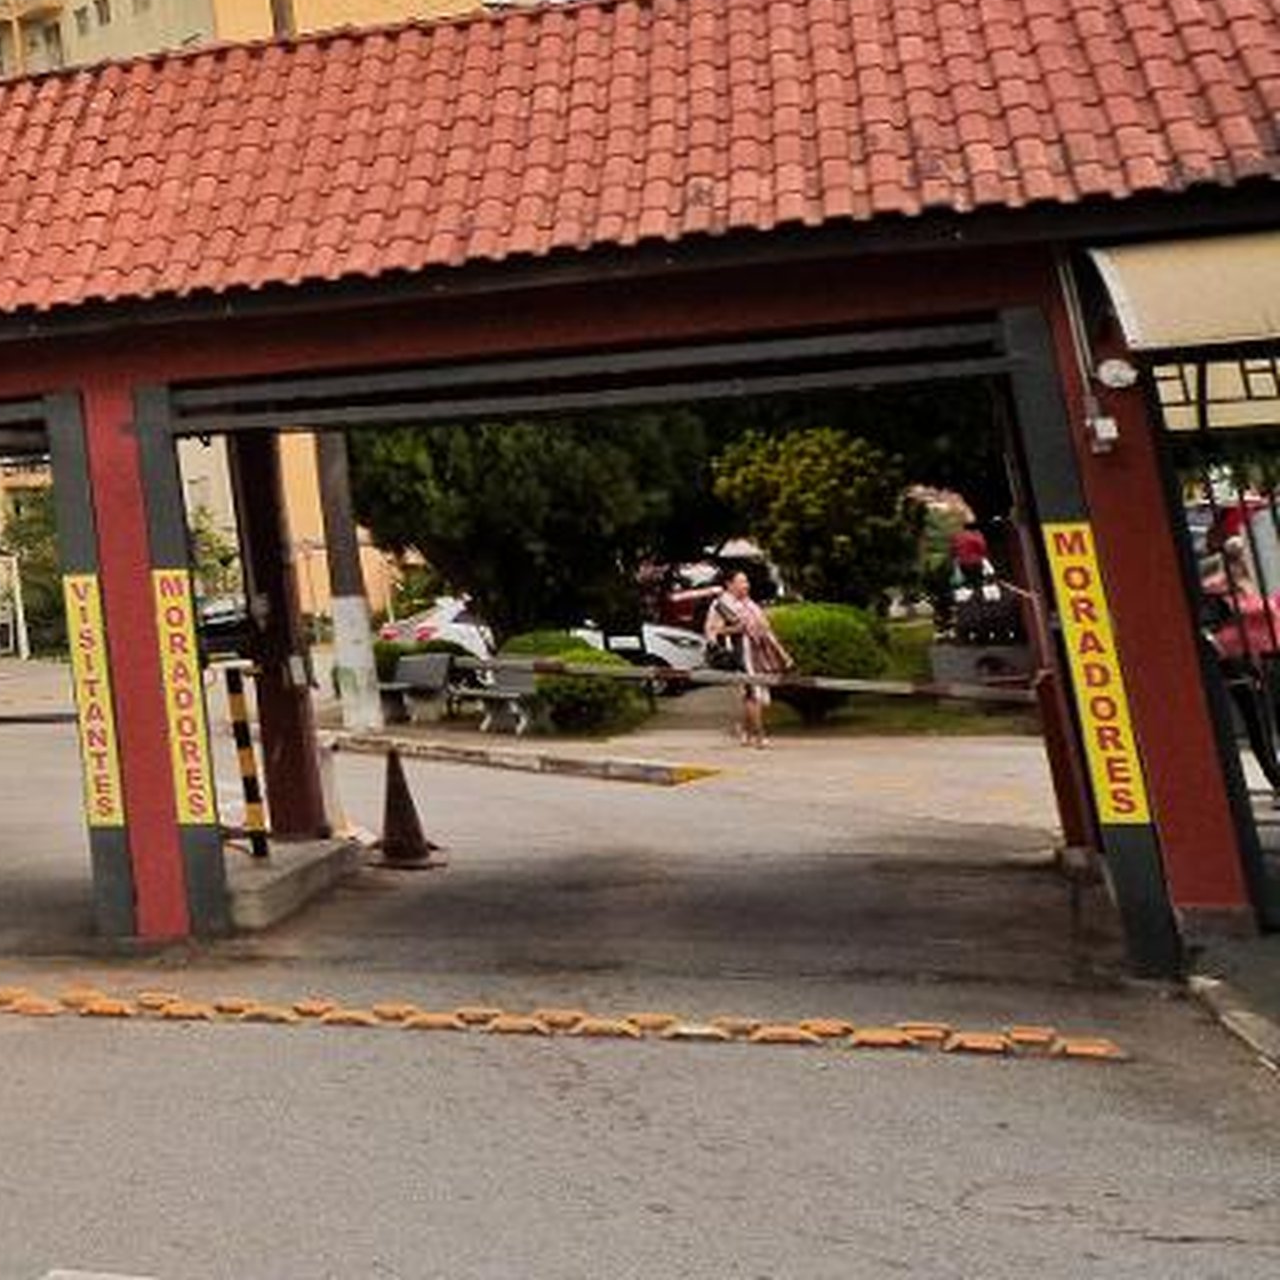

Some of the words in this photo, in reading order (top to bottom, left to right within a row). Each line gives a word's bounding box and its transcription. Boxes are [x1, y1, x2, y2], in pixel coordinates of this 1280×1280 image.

[70, 581, 113, 817] VISITANTES
[158, 577, 208, 815] MORADORES
[1052, 532, 1137, 814] MORADORES
